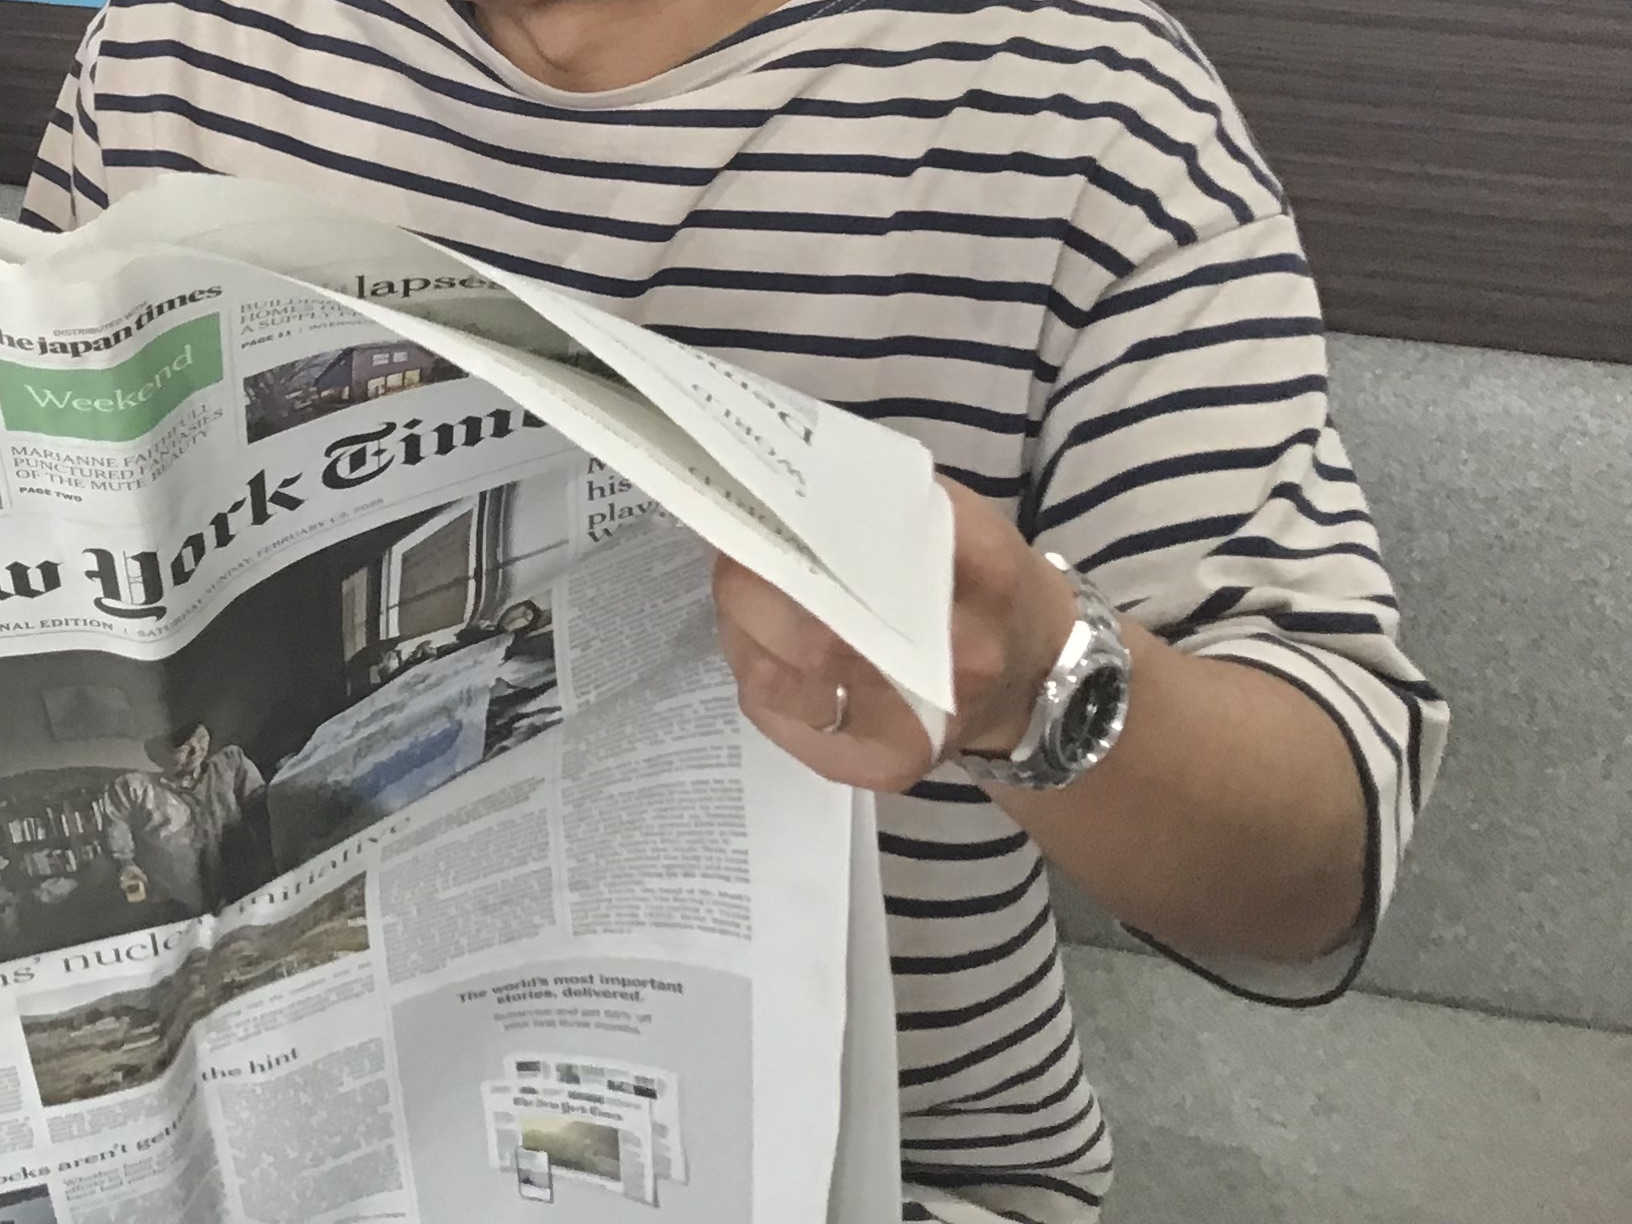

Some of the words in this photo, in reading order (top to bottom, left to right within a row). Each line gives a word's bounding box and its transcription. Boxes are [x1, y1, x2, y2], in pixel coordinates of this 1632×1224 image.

[38, 326, 133, 358] japan
[135, 285, 223, 331] times
[24, 344, 193, 412] Weekend
[11, 446, 118, 468] MARIANNE
[14, 457, 134, 480] PUNCTURED
[15, 469, 40, 480] OF
[45, 473, 85, 489] THE
[90, 478, 145, 492] MUTE
[19, 486, 51, 496] PAGE
[55, 490, 83, 503] TWO
[81, 468, 308, 622] York
[321, 408, 548, 490] Tim
[39, 616, 114, 632] EDITION
[457, 989, 487, 1003] The
[553, 973, 594, 985] most
[599, 973, 684, 995] important
[249, 1047, 298, 1075] hint
